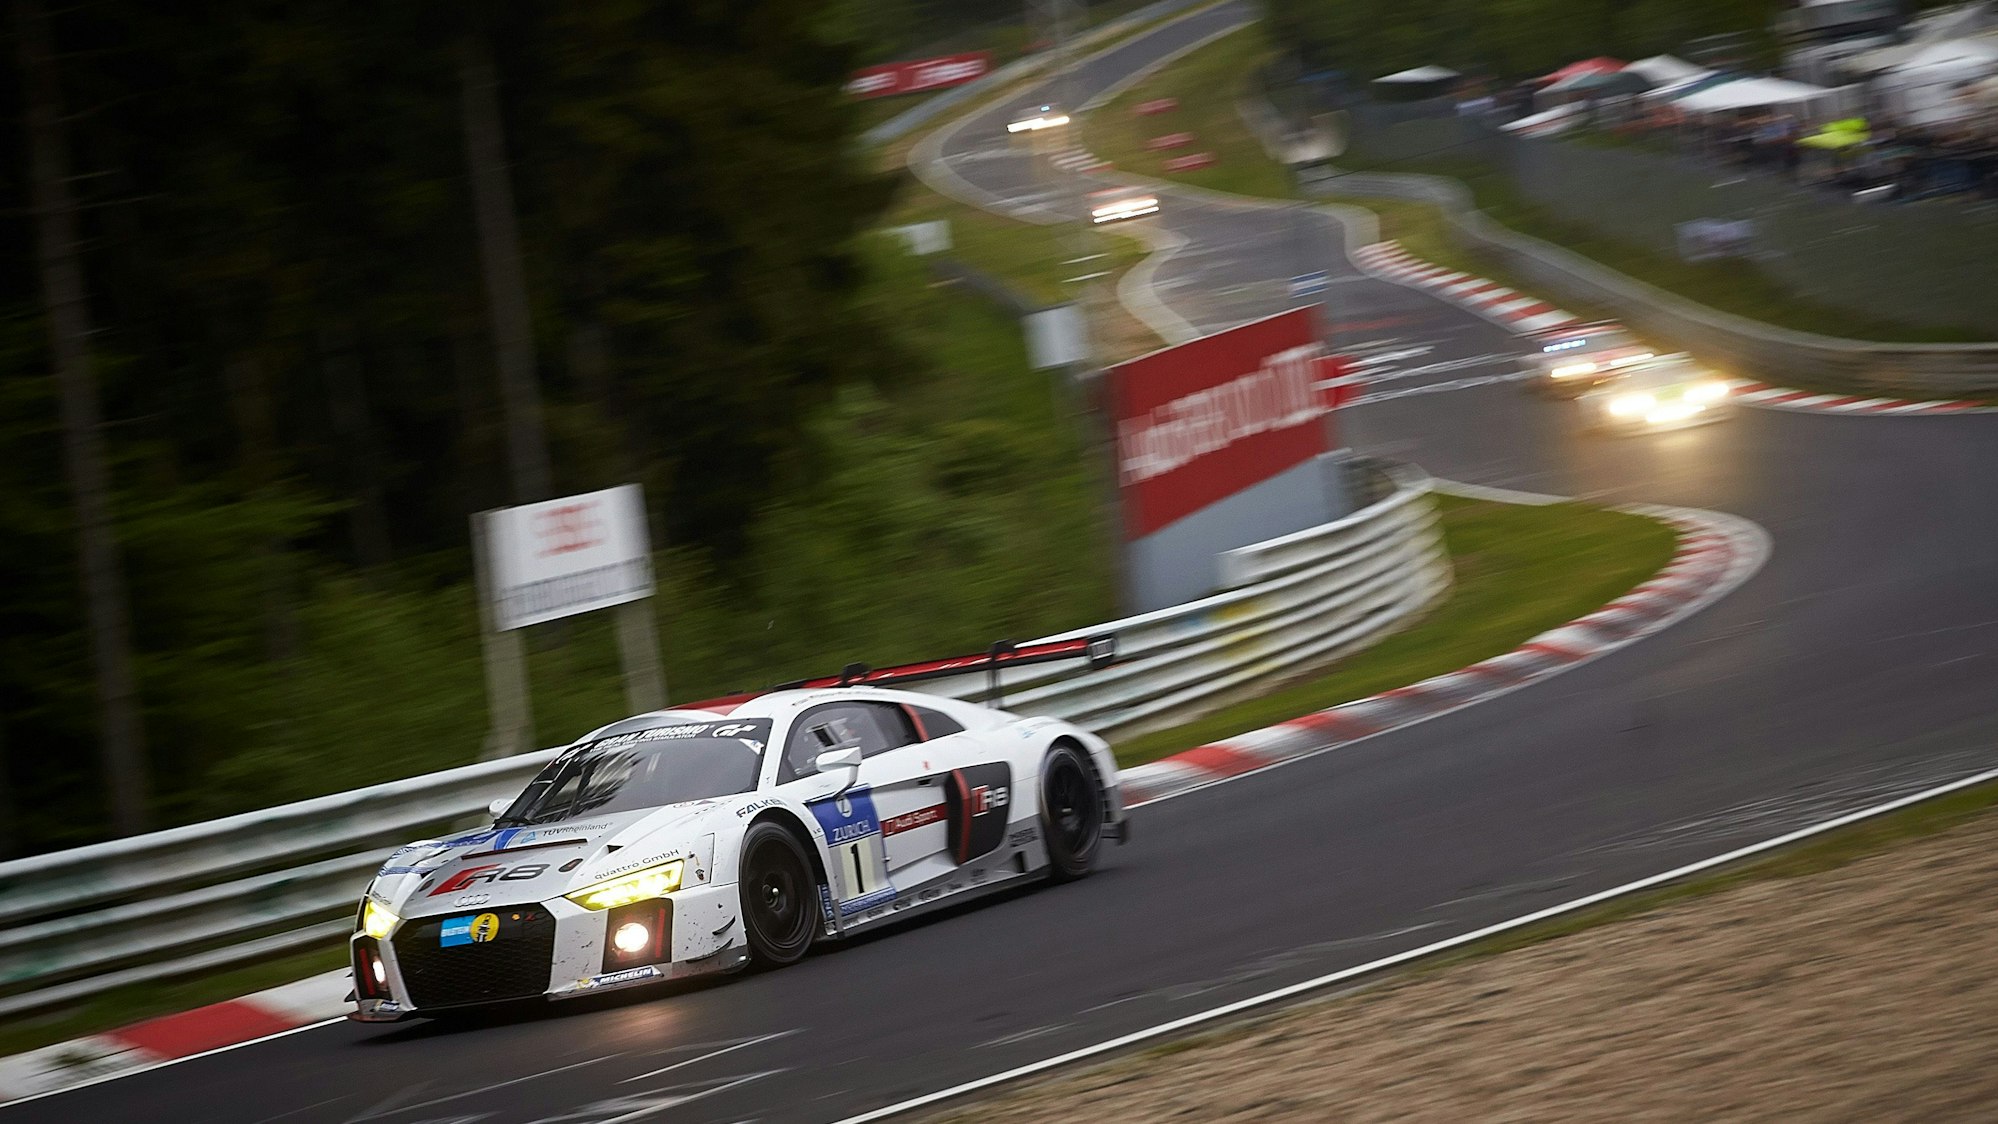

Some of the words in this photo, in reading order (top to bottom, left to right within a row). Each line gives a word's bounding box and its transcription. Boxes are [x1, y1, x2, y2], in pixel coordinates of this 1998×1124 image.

[593, 731, 641, 749] GRAN
[637, 725, 710, 740] TURISMO
[981, 786, 1009, 810] R8
[833, 820, 871, 841] ZURICH
[450, 863, 551, 890] R8
[594, 862, 640, 880] quattro
[642, 849, 680, 864] GmbH
[850, 843, 865, 894] 1
[600, 967, 652, 984] MICHELIN
